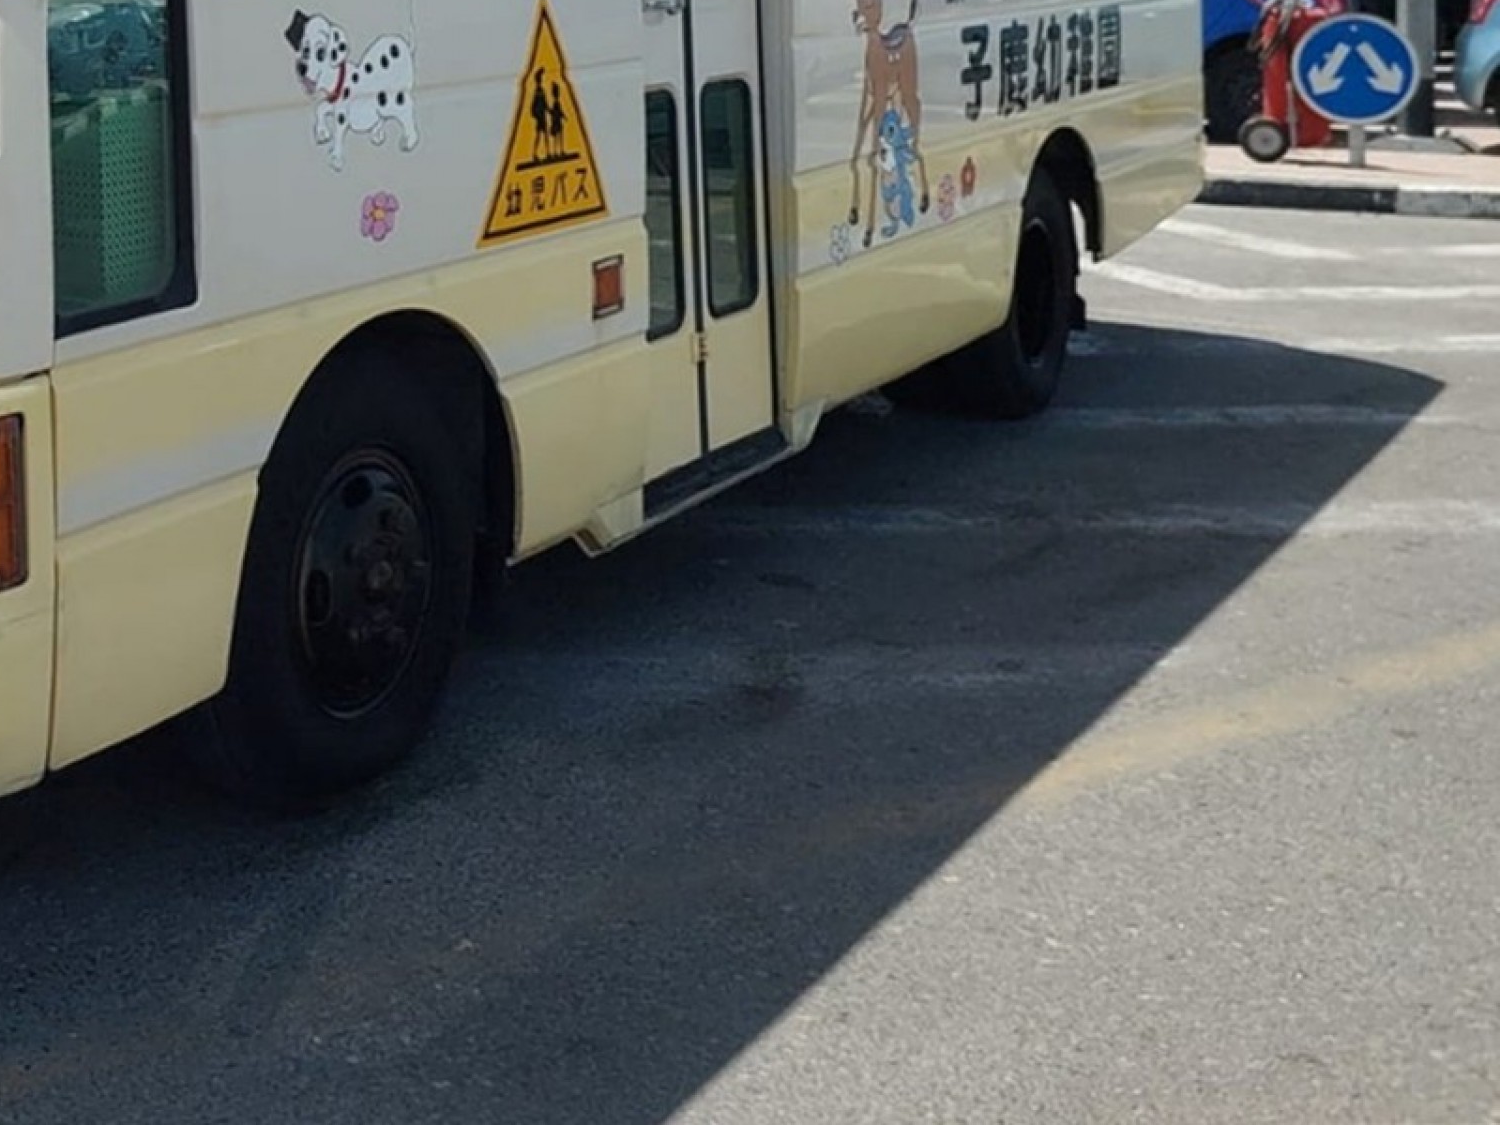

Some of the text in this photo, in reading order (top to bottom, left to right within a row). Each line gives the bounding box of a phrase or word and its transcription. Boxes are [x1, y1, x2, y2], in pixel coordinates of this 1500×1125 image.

[960, 4, 1122, 122] 子鹿幼稚園
[505, 168, 588, 217] 幼児バス
